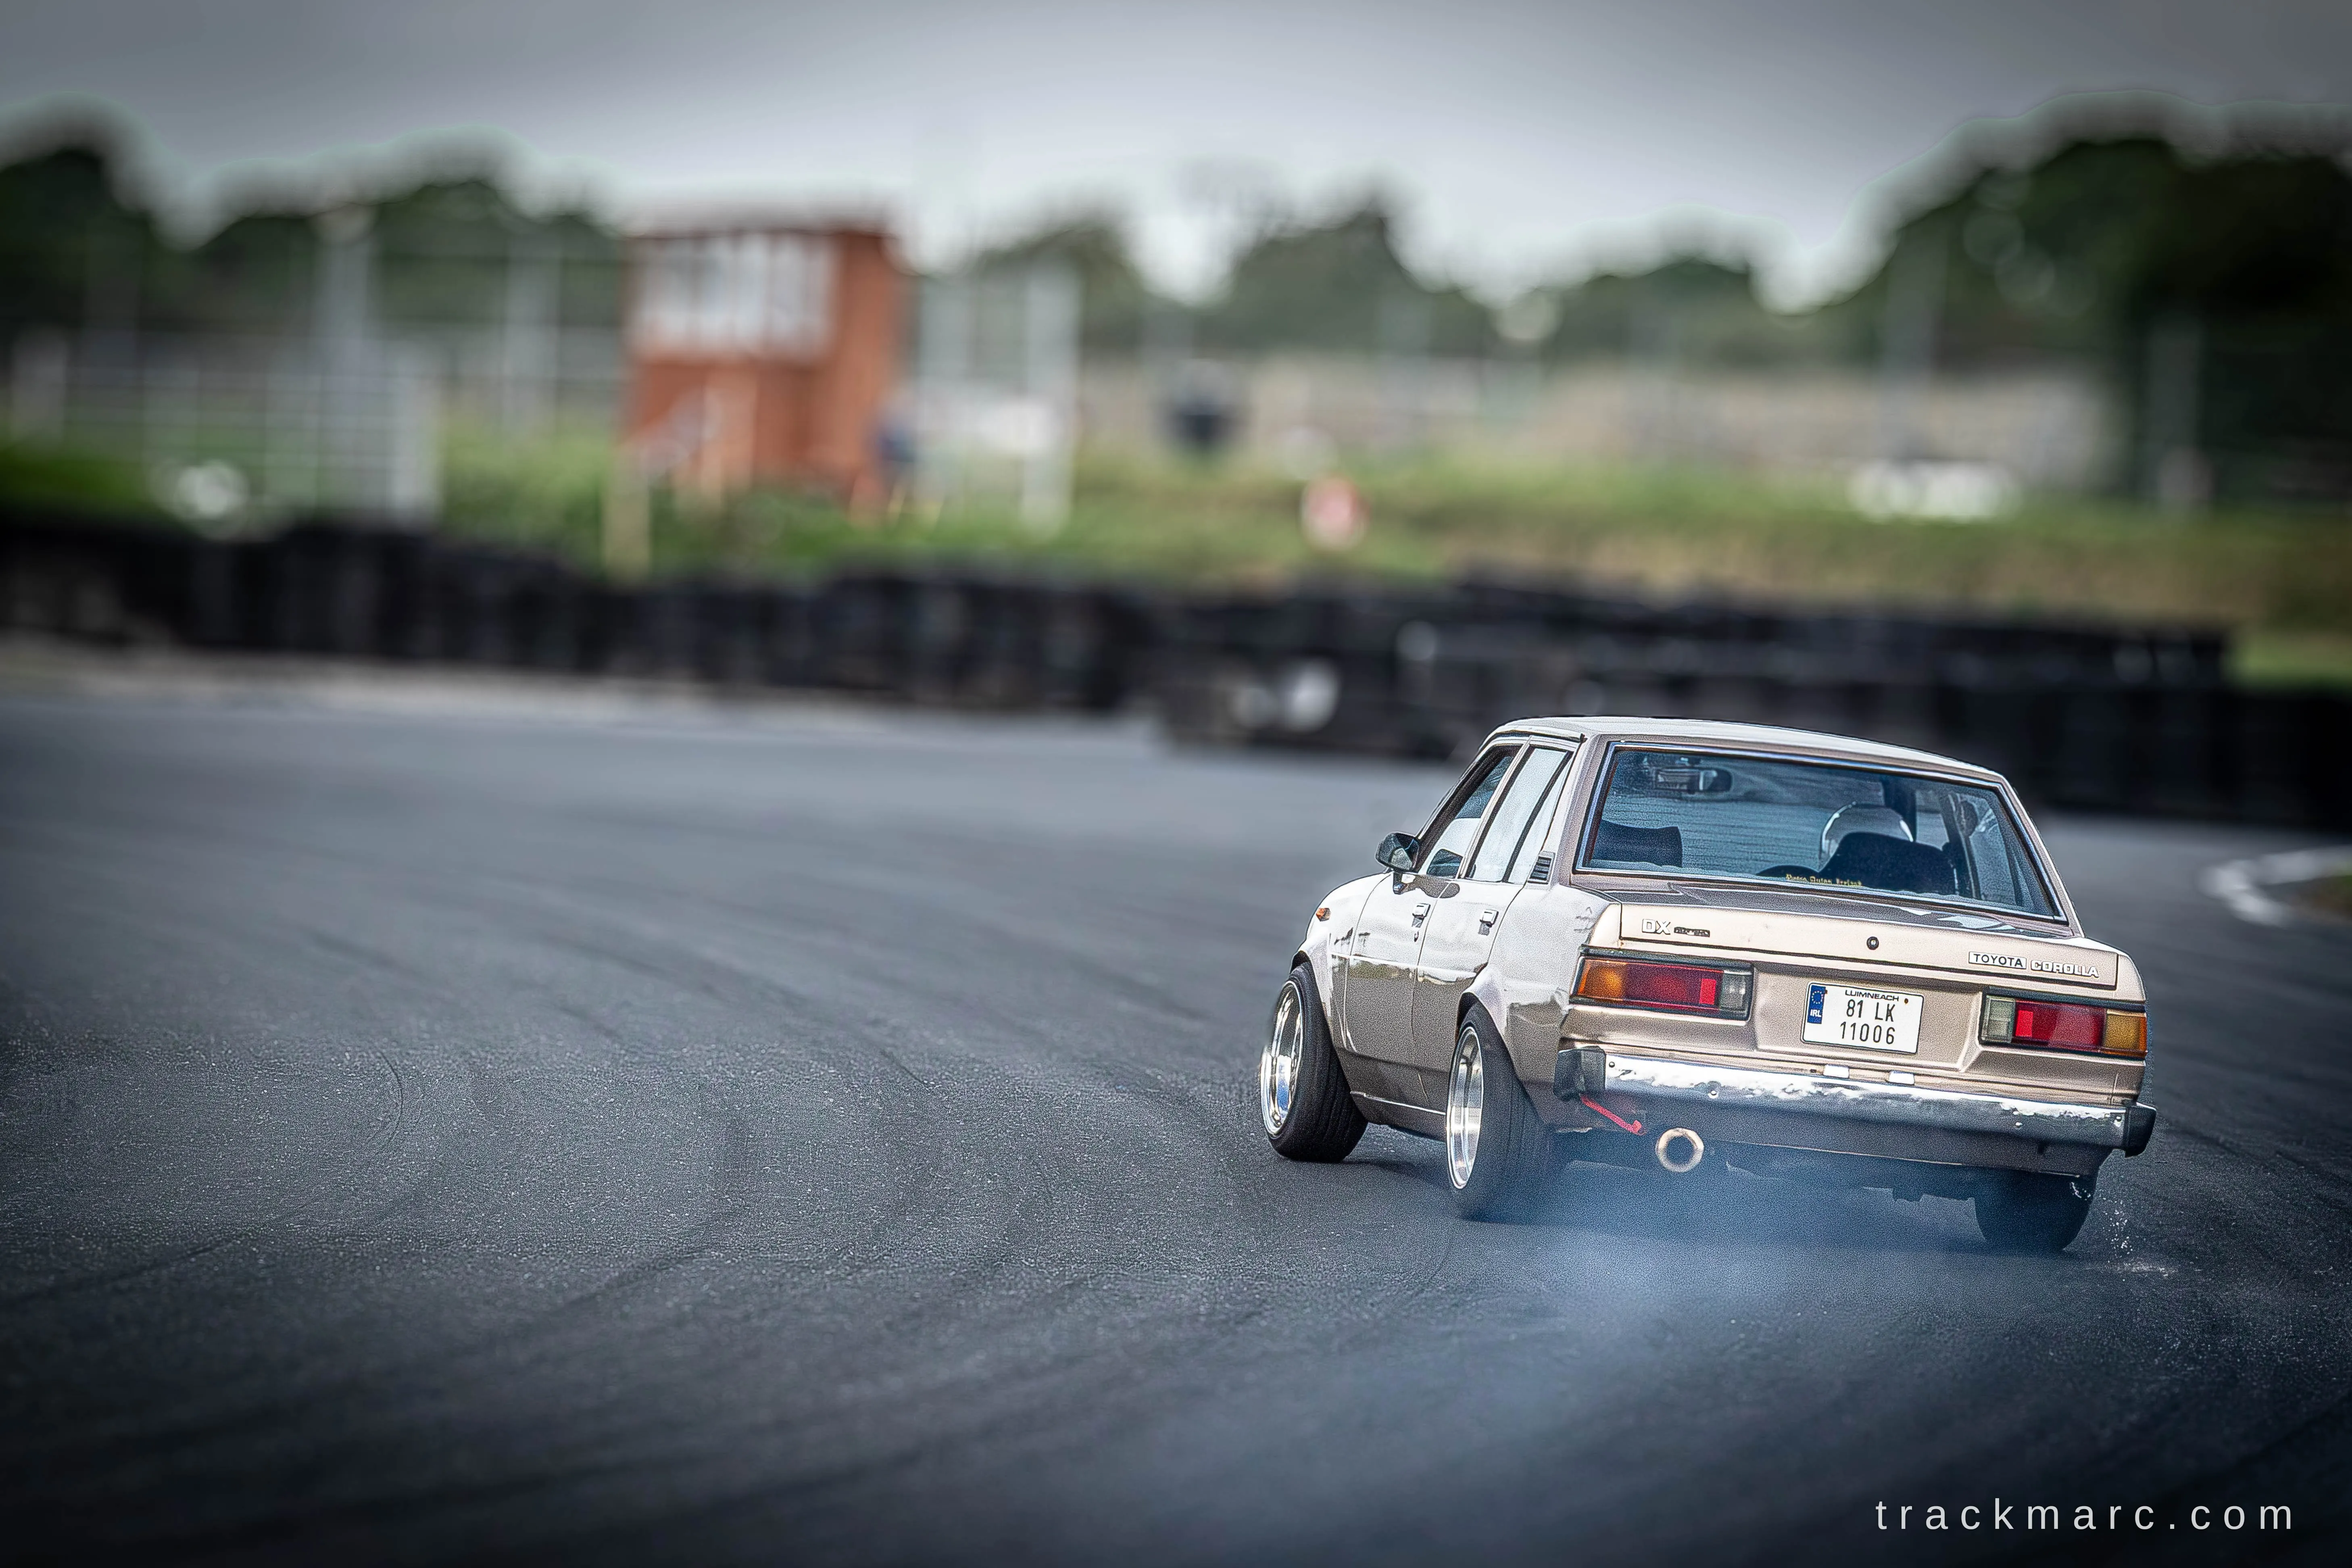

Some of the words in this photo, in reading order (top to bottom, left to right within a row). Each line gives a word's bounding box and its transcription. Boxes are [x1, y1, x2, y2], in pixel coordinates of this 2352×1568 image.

[1642, 919, 1670, 935] DX
[1973, 953, 2023, 968] TOYOTA
[2031, 959, 2100, 978] COROLLA
[1845, 989, 1900, 1002] LUIMNEACH
[1810, 1009, 1822, 1018] IRL
[1846, 999, 1864, 1018] 81
[1875, 1002, 1896, 1022] LK
[1840, 1021, 1895, 1045] 11006
